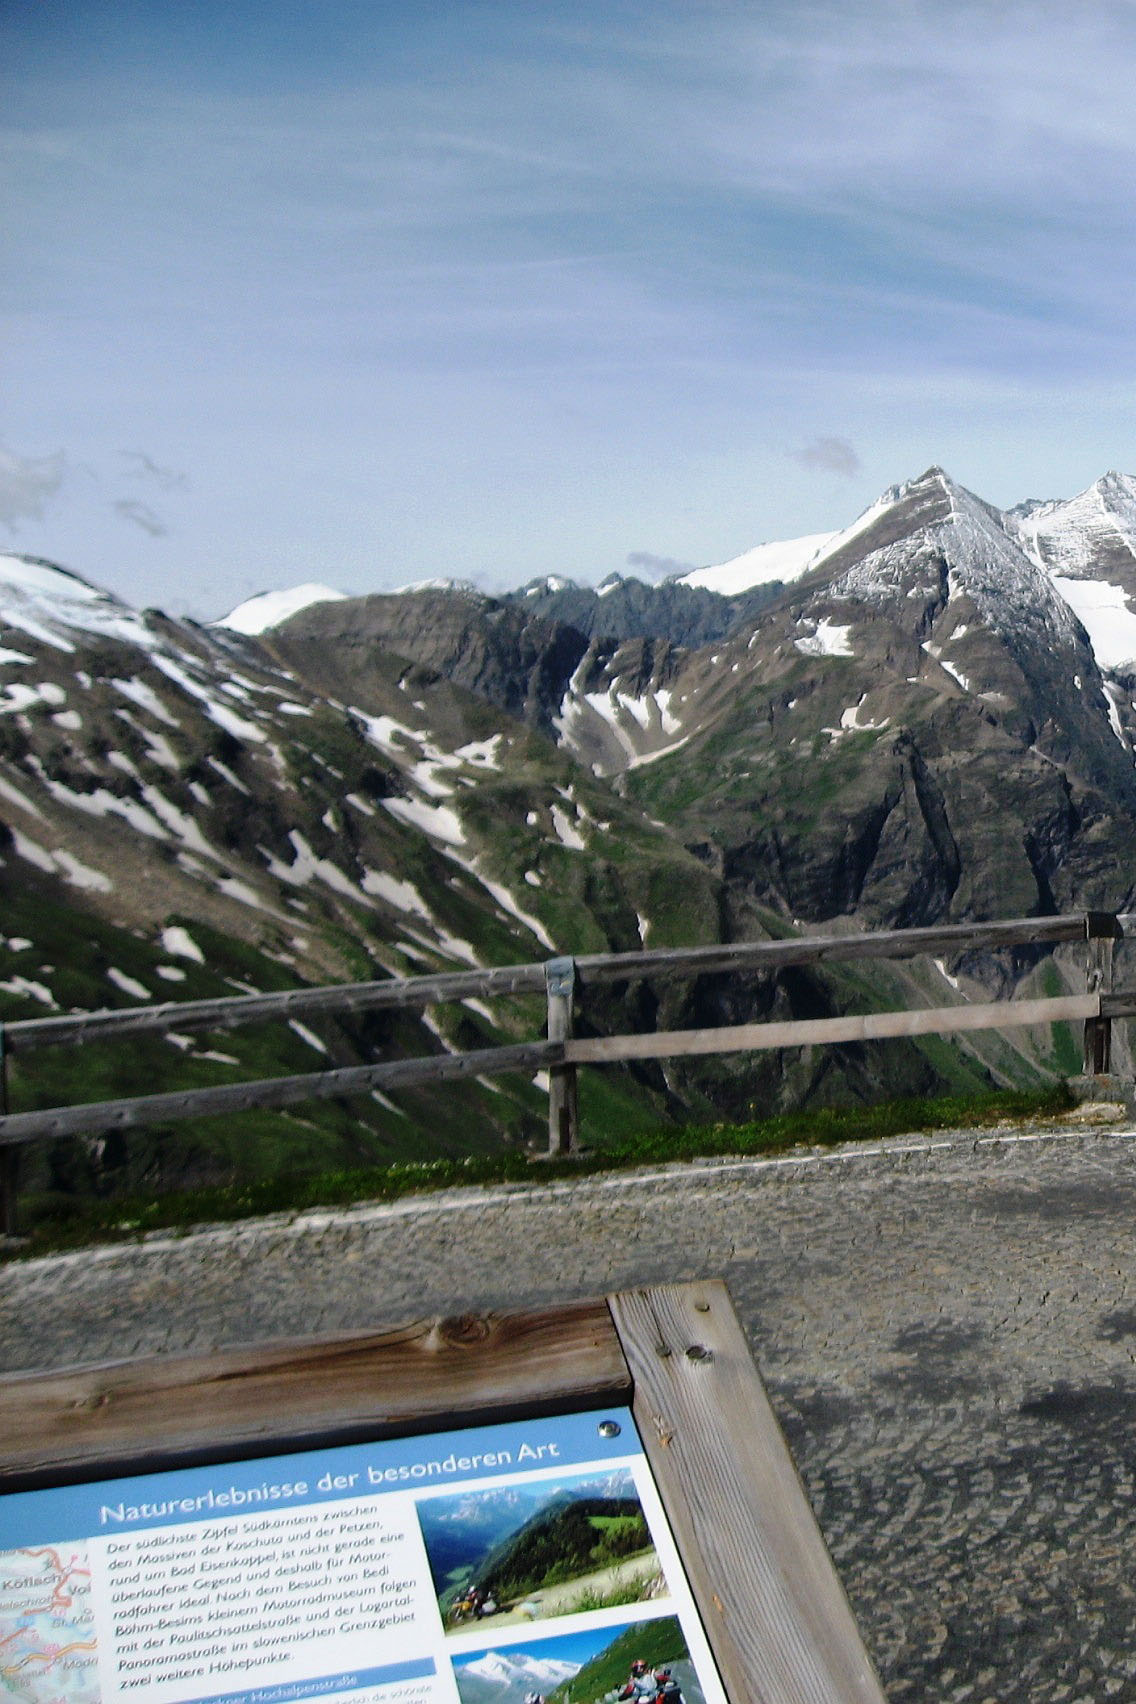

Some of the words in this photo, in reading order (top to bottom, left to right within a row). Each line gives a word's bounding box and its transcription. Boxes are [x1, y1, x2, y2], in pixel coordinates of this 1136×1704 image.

[100, 1479, 308, 1525] Naturerlebnisse
[317, 1471, 360, 1492] der
[368, 1450, 511, 1484] besonderen
[517, 1442, 560, 1462] Art
[107, 1543, 130, 1555] Der
[136, 1532, 197, 1550] südlichste
[202, 1525, 238, 1540] Zipfel
[323, 1504, 378, 1521] zwischen
[108, 1558, 132, 1570] den
[137, 1550, 196, 1566] Massiven
[201, 1544, 221, 1556] der
[288, 1530, 311, 1542] und
[316, 1527, 335, 1538] der
[339, 1520, 384, 1534] Petzen,
[110, 1572, 140, 1586] rund
[145, 1571, 166, 1581] um
[170, 1563, 196, 1577] Bad
[200, 1551, 279, 1572] Eisenkappel,
[282, 1548, 295, 1559] ist
[300, 1543, 330, 1556] nicht
[334, 1536, 375, 1553] gerade
[380, 1532, 405, 1543] eine
[112, 1583, 188, 1603] überlaufene
[193, 1573, 241, 1590] Gegend
[246, 1569, 270, 1581] und
[275, 1561, 323, 1577] deshalb
[327, 1557, 344, 1570] für
[349, 1551, 391, 1565] Motor-
[112, 1603, 174, 1619] radfahrer
[216, 1588, 250, 1602] Nach
[255, 1584, 283, 1597] dem
[288, 1575, 332, 1591] Besuch
[338, 1572, 358, 1583] von
[363, 1565, 389, 1579] Bedi
[208, 1605, 257, 1622] kleinem
[263, 1587, 376, 1612] Motorradmuseum
[380, 1579, 417, 1595] folgen
[116, 1642, 138, 1654] mit
[143, 1637, 165, 1650] der
[306, 1609, 330, 1622] und
[335, 1605, 355, 1617] der
[118, 1645, 226, 1671] Panoramastraße
[232, 1641, 248, 1652] im
[253, 1627, 336, 1649] slowenischen
[340, 1612, 415, 1633] Grenzgebiet
[119, 1674, 151, 1690] zwei
[157, 1666, 204, 1683] weitere
